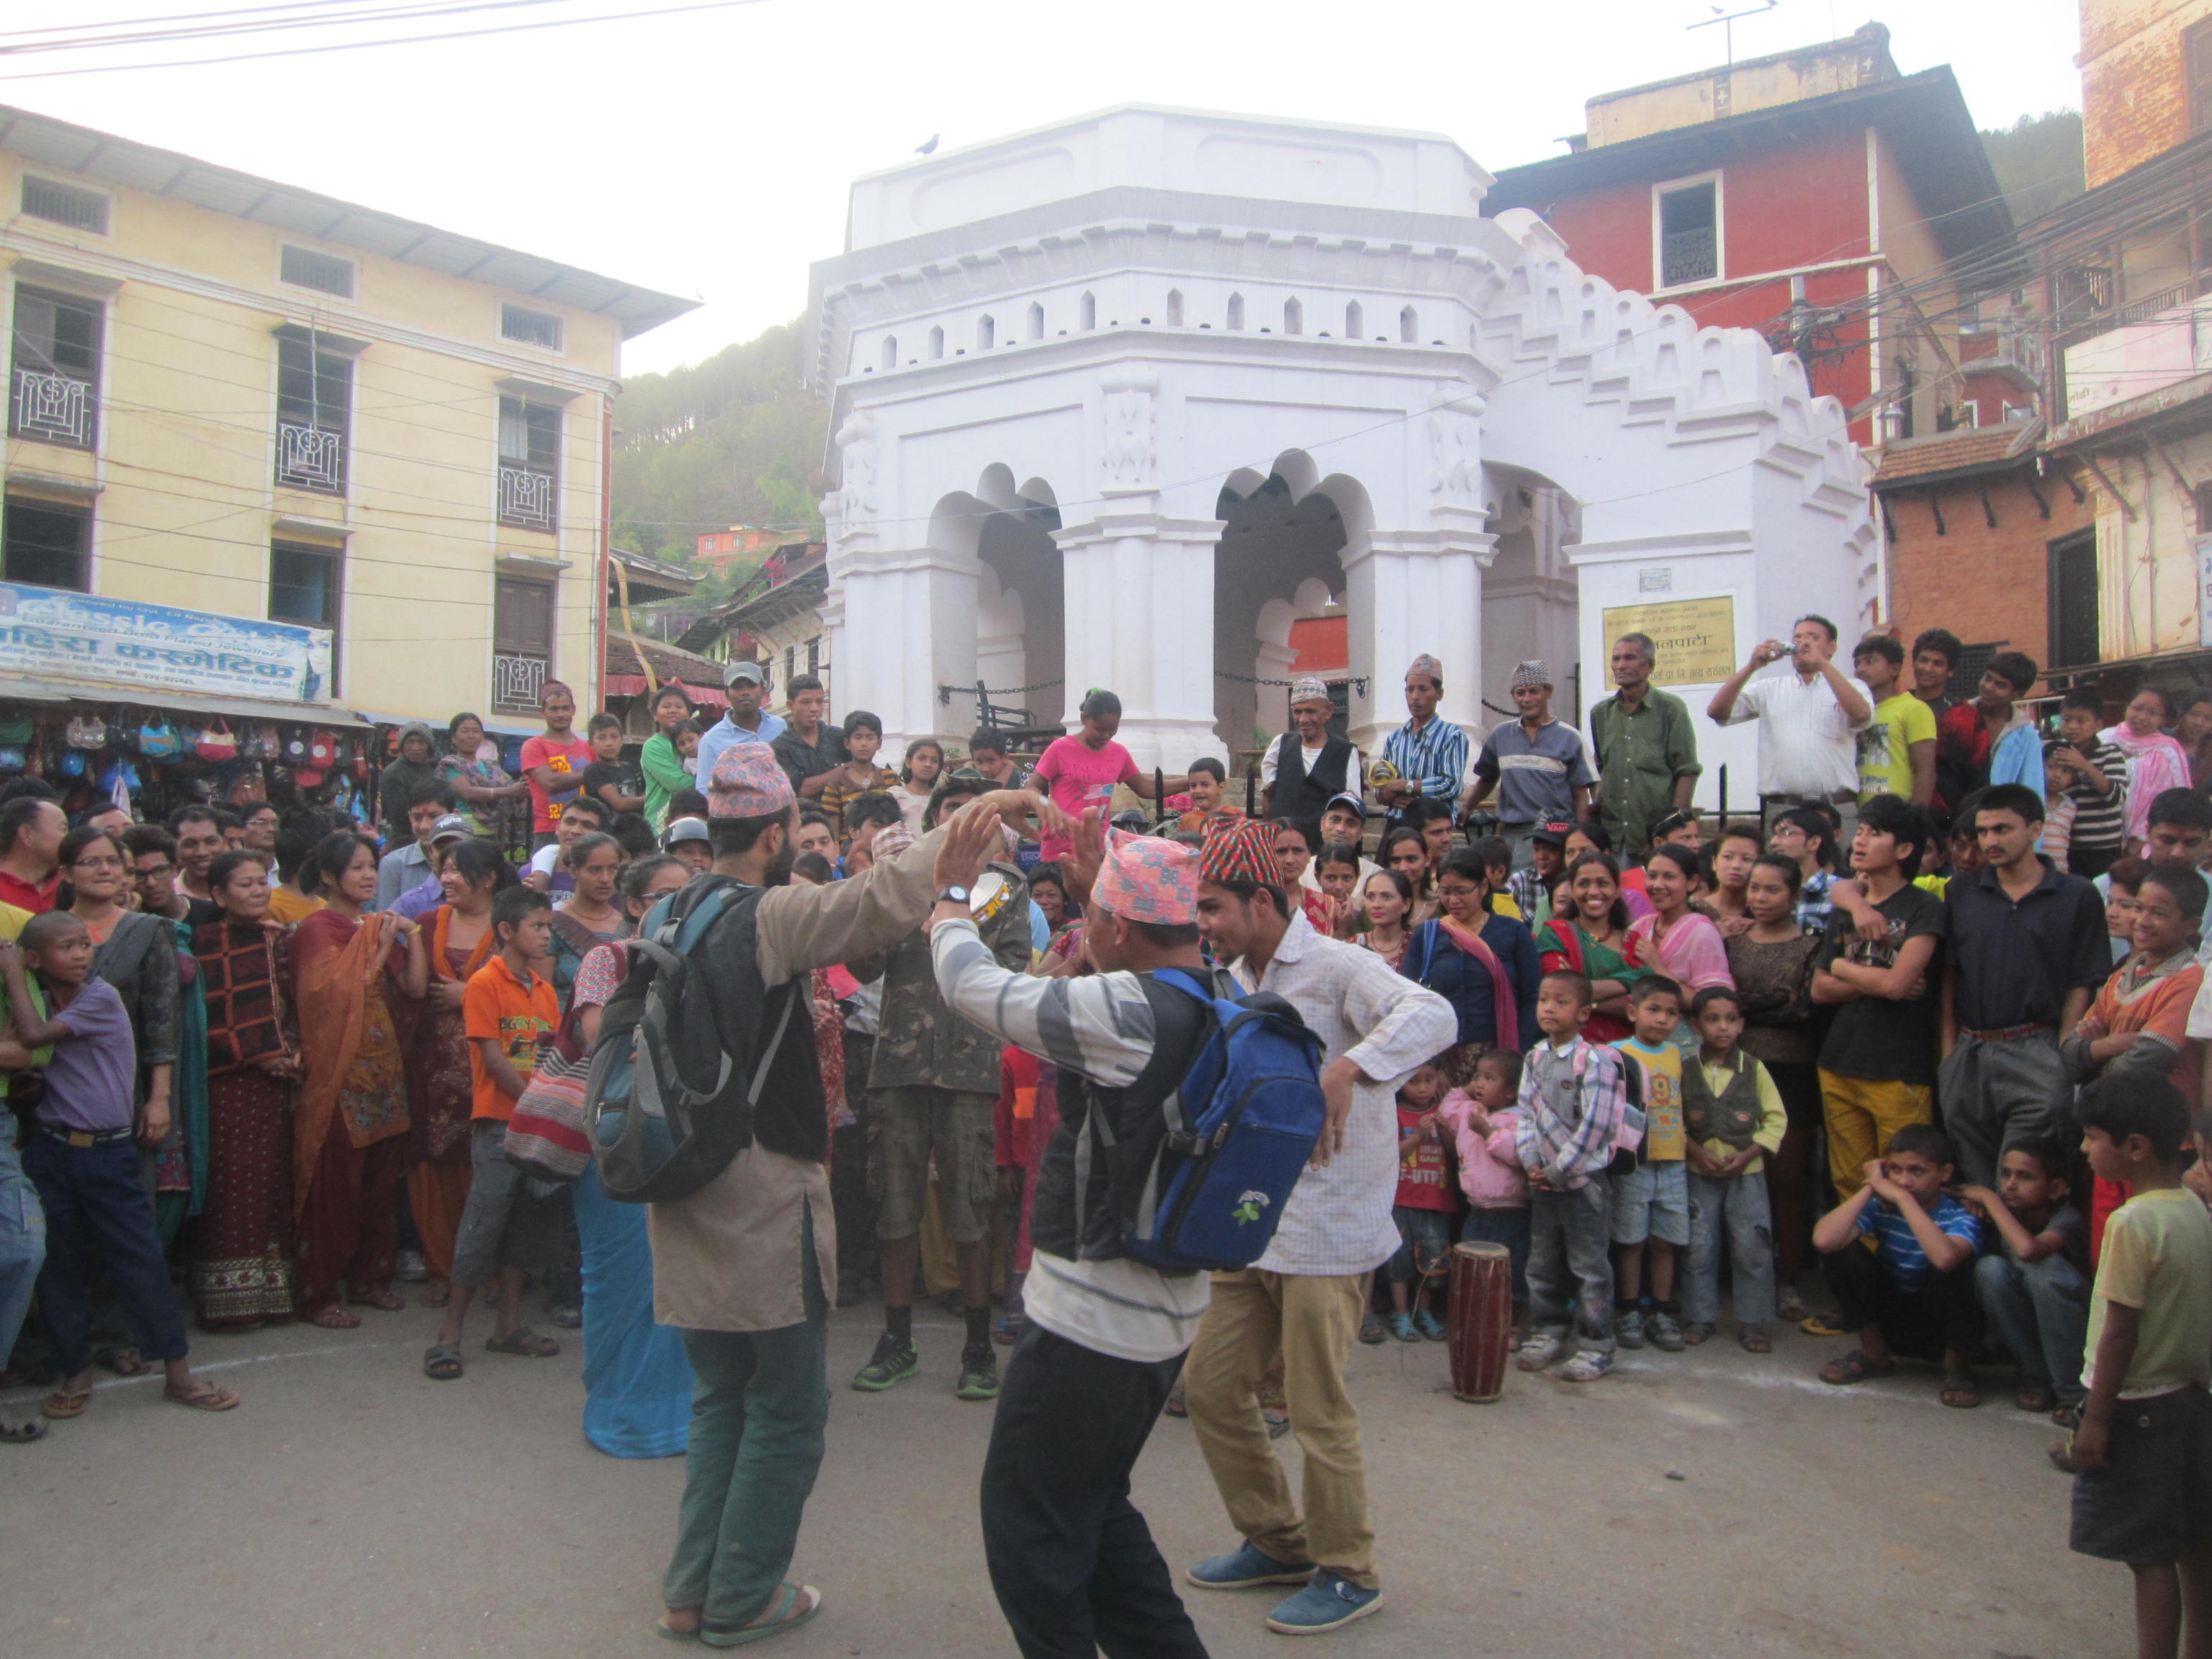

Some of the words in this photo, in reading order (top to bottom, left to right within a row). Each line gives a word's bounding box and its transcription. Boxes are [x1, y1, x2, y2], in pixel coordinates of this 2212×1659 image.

[22, 616, 120, 635] Guaranteed
[164, 635, 212, 648] Plated
[218, 641, 283, 658] Jewellery
